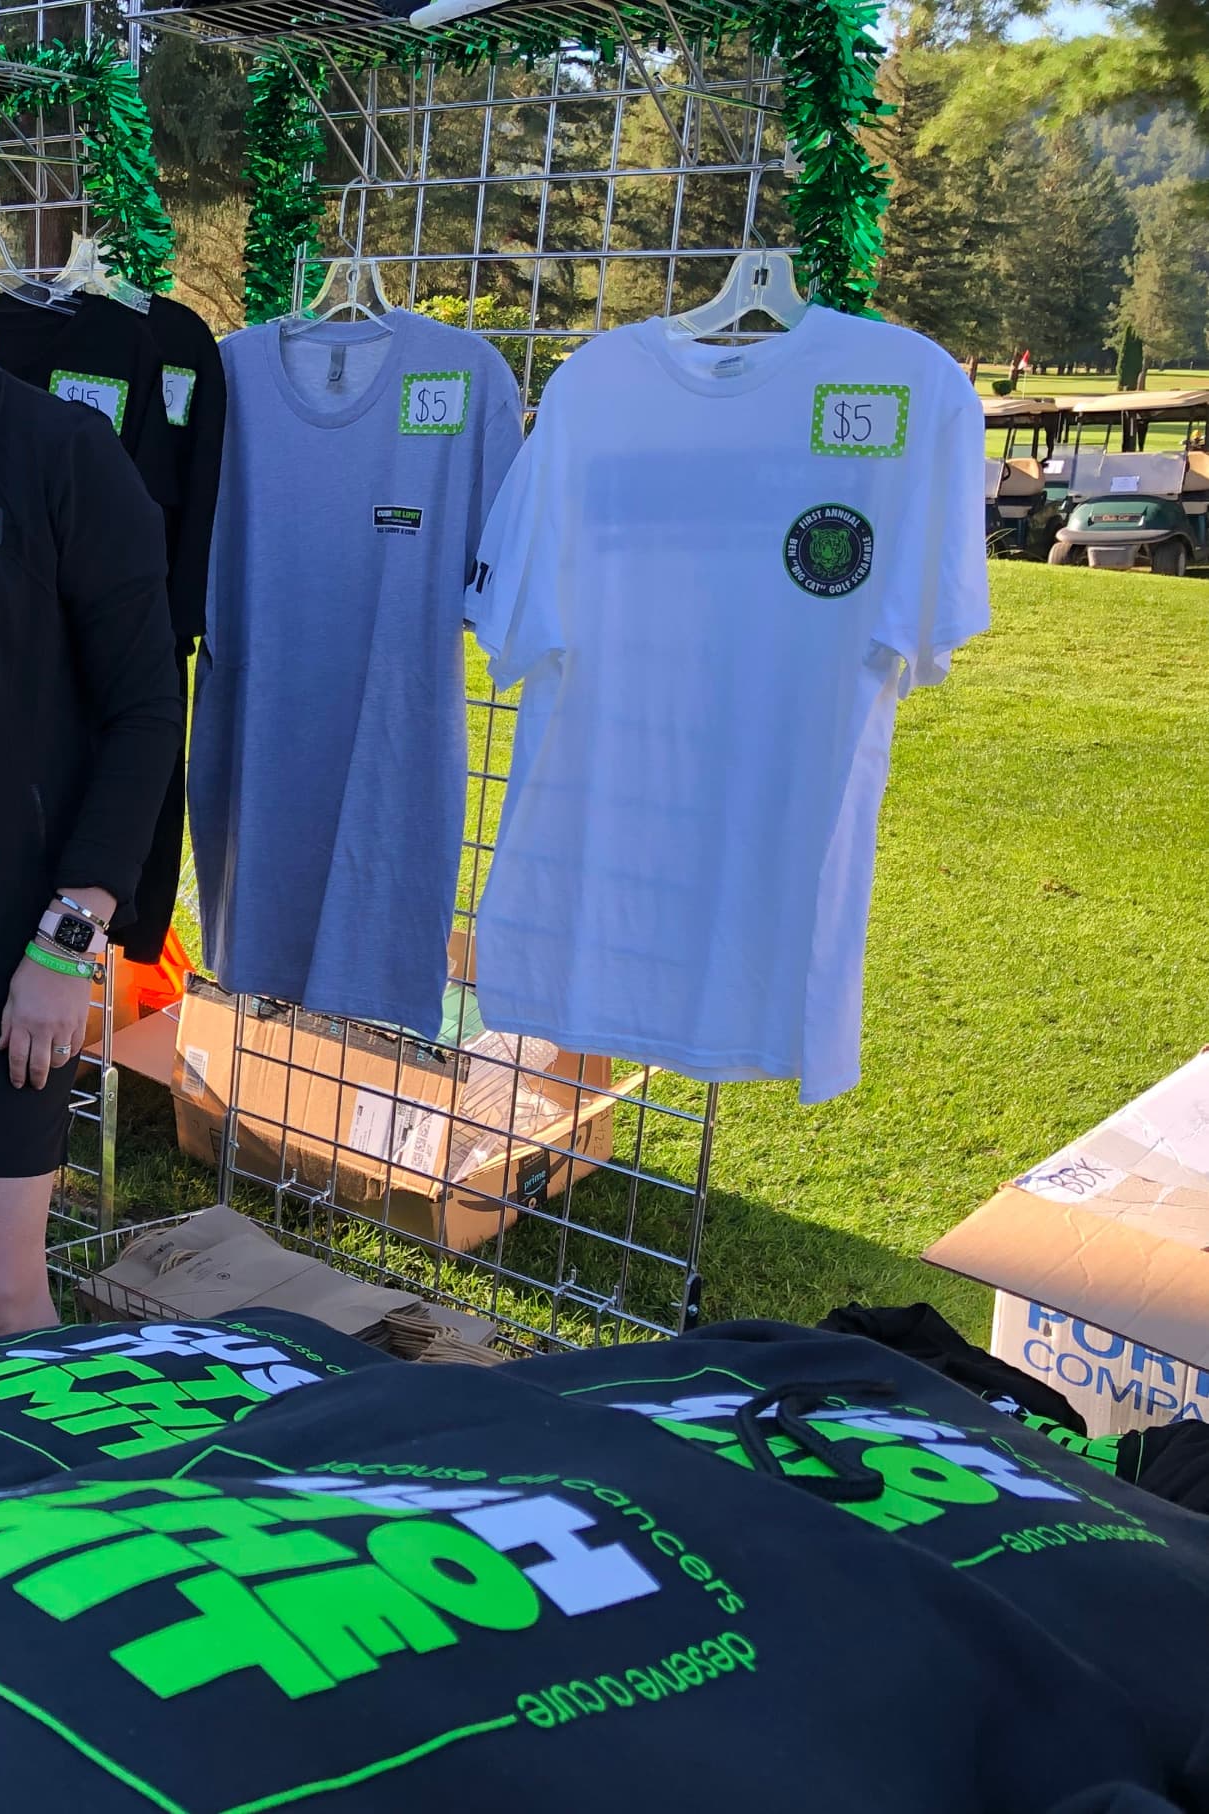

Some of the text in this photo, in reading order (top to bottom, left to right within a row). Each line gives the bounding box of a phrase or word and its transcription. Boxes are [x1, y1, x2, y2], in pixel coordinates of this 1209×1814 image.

[416, 387, 447, 422] $5
[833, 400, 872, 442] $5
[798, 508, 861, 530] FIRST ANNUAL
[787, 538, 798, 557] BEN
[829, 580, 851, 594] GOLF
[851, 536, 872, 584] SCRAMBLE
[524, 1170, 546, 1191] prime
[139, 1325, 324, 1394] CUS
[226, 1322, 324, 1363] Because
[1027, 1302, 1209, 1401] POR
[62, 1354, 228, 1441] TH
[180, 1365, 273, 1422] T
[561, 1478, 746, 1615] cancers
[1001, 1526, 1067, 1553] cure
[517, 1631, 757, 1729] deserve a cure
